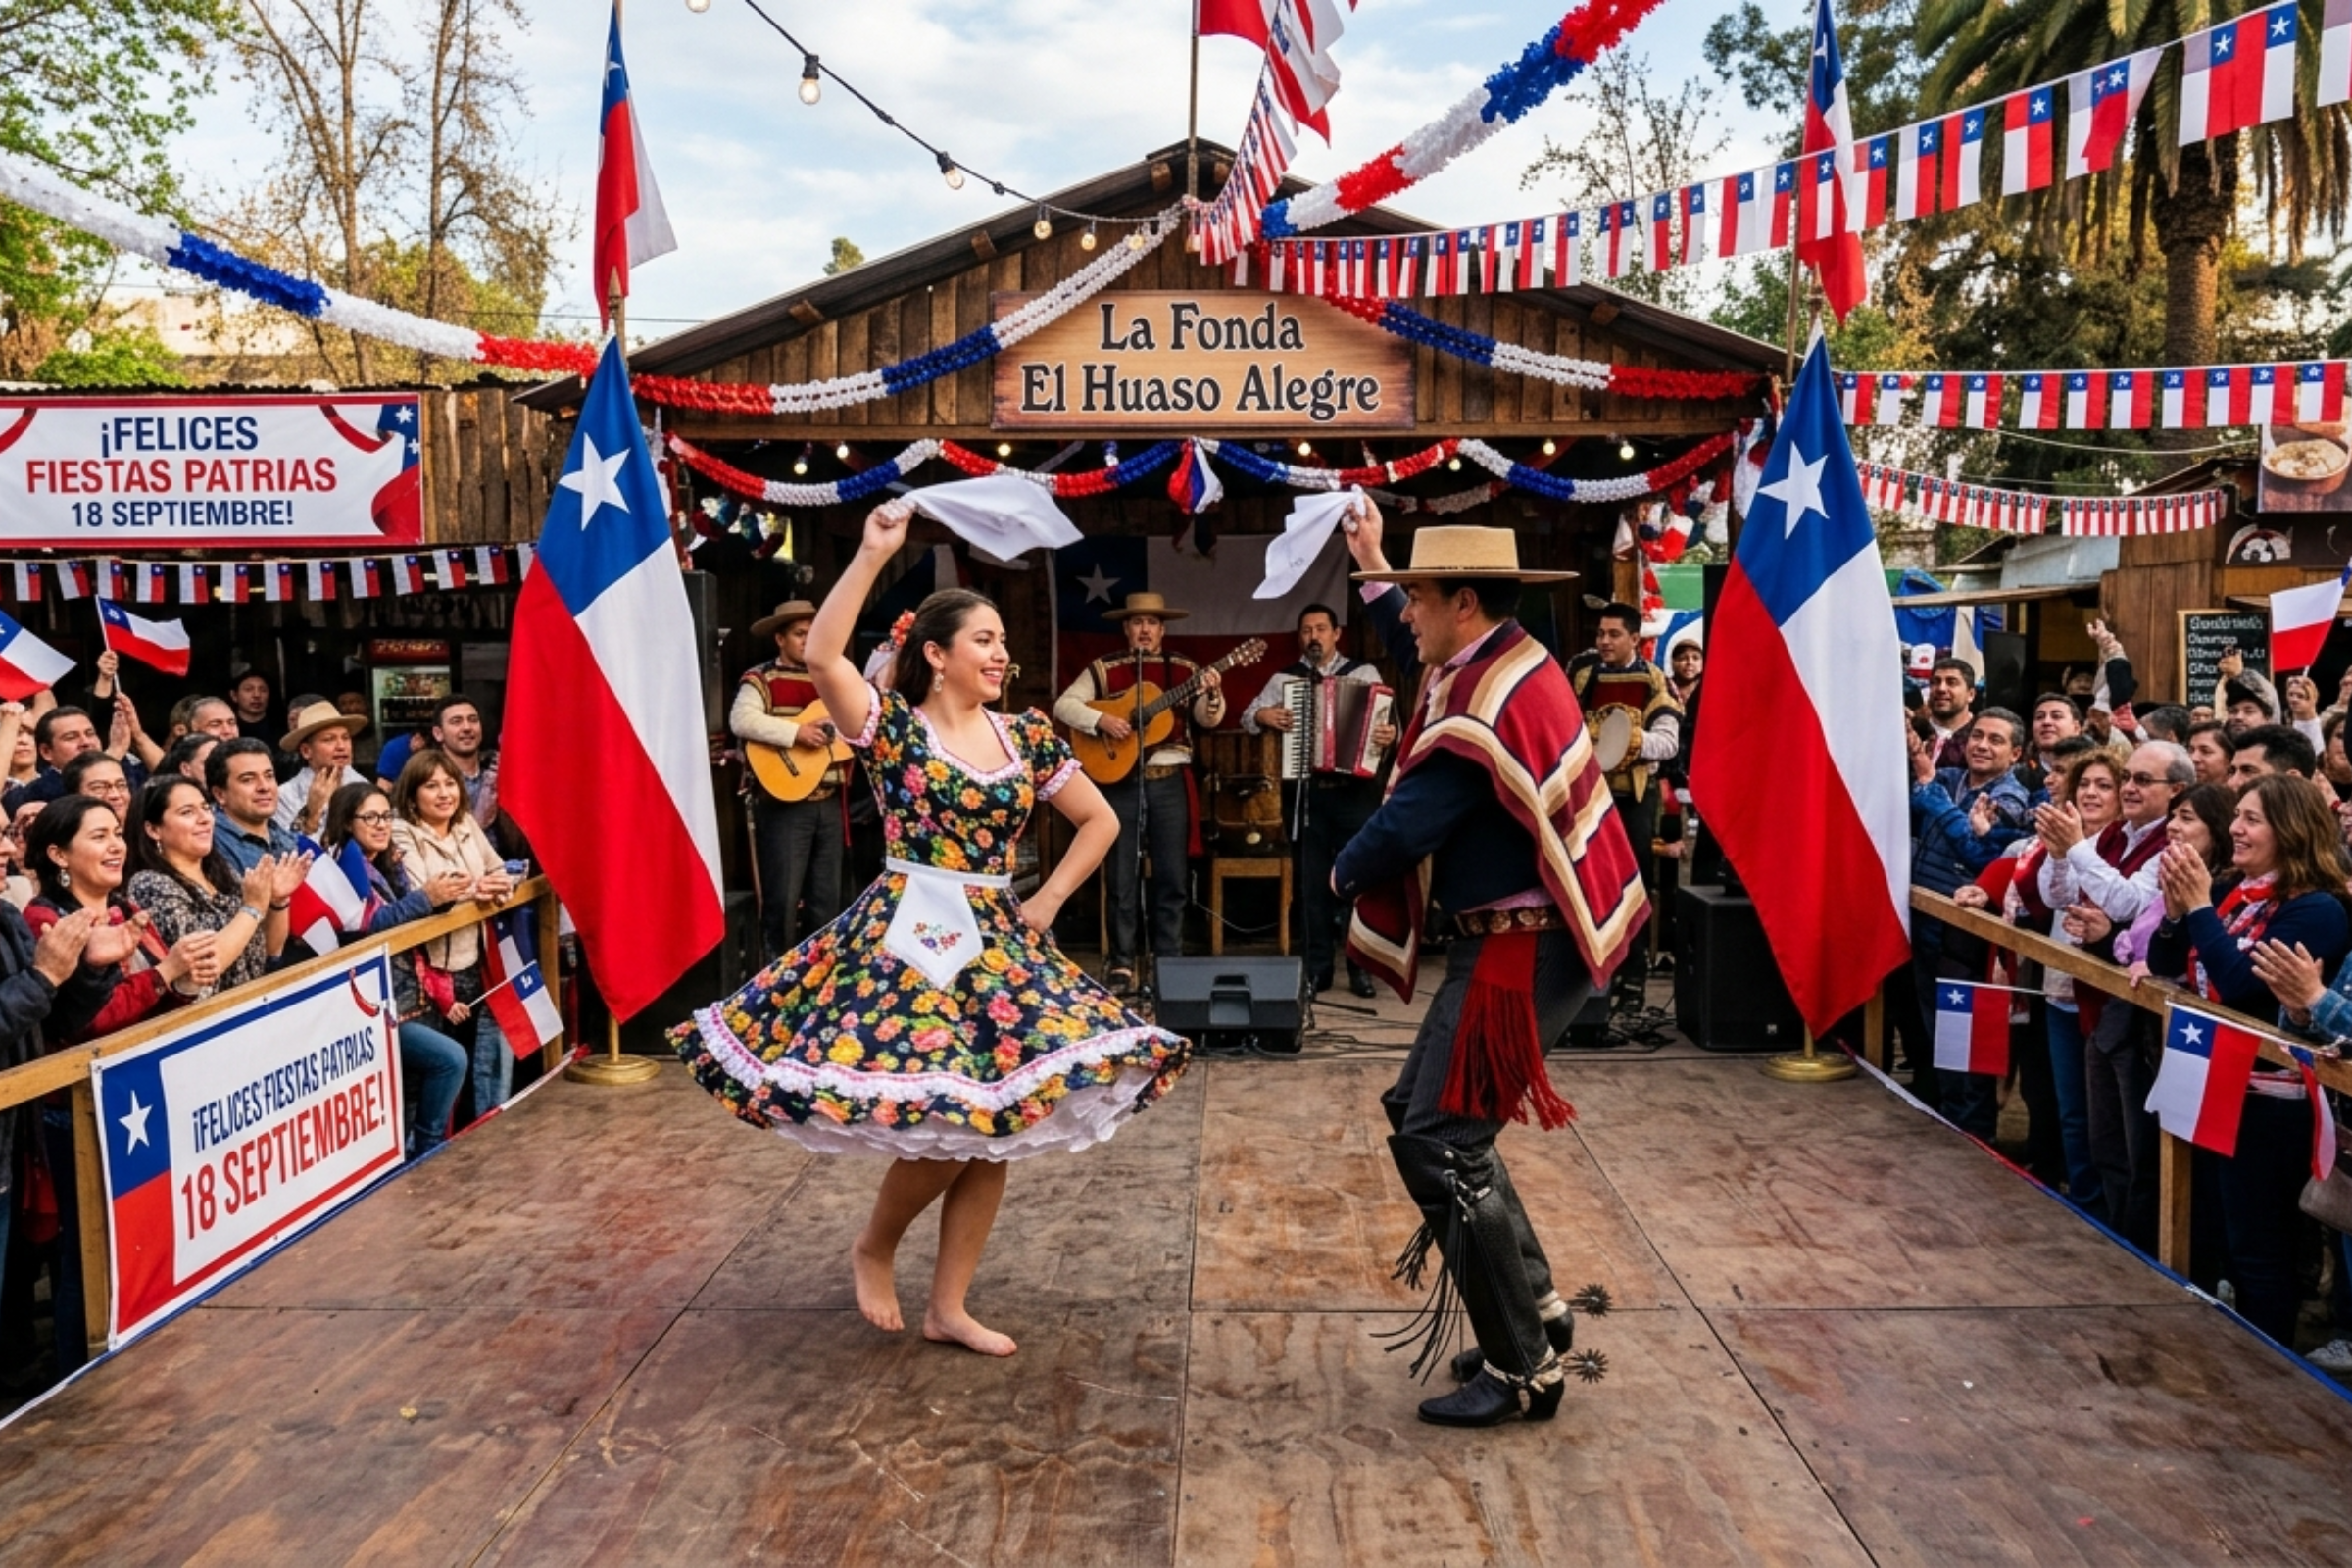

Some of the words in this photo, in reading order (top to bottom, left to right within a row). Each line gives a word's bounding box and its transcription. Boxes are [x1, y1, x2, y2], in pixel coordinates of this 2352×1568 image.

[1100, 303, 1155, 351] La
[1171, 302, 1304, 351] Fonda
[1021, 364, 1066, 413] El
[1082, 364, 1222, 413] Huaso
[1236, 364, 1380, 421] Alegre
[102, 416, 259, 458] ¡FELICES
[26, 459, 172, 493] FIESTAS
[184, 458, 337, 492] PATRIAS
[72, 502, 103, 527] 18
[112, 500, 293, 526] SEPTIEMBRE!
[192, 1081, 262, 1153] ¡FELICES
[263, 1052, 319, 1115] FIESTAS
[321, 1026, 375, 1086] PATRIAS
[181, 1163, 217, 1240] 18
[222, 1070, 386, 1214] SEPTIEMBRE!
